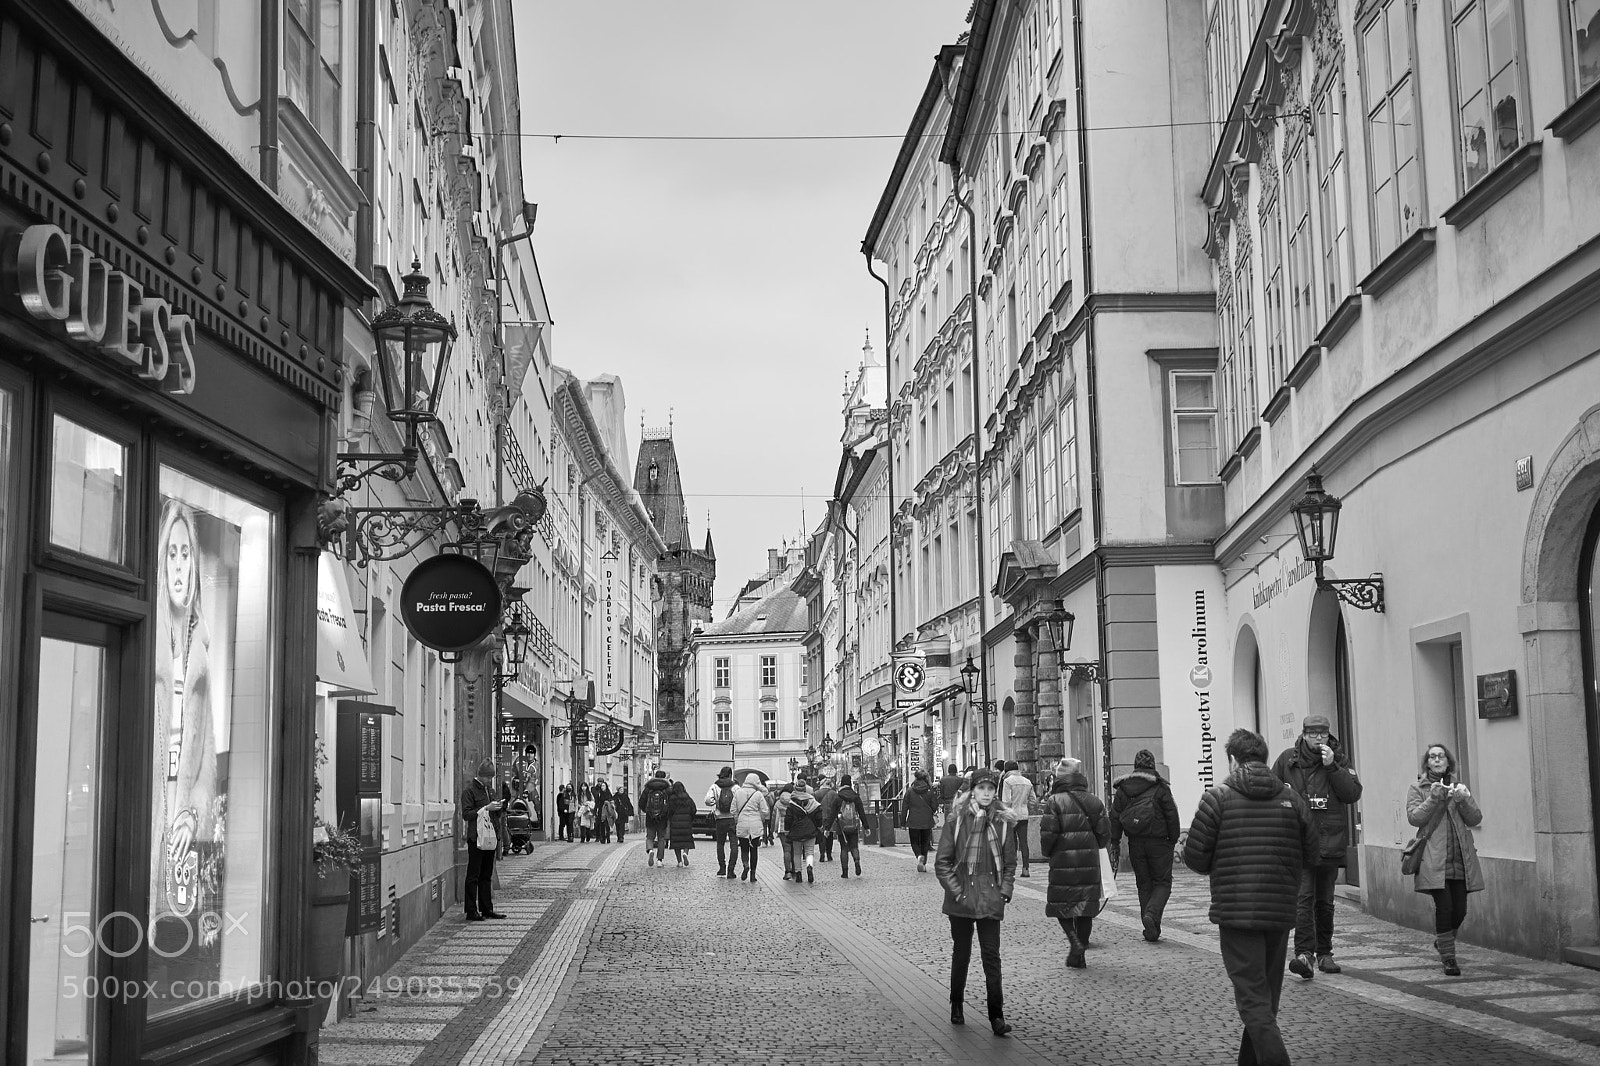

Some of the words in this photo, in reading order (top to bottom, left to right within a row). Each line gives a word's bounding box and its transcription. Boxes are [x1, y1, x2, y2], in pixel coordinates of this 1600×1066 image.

[18, 224, 196, 395] GUESS
[416, 602, 446, 612] Pasta
[448, 602, 486, 612] Fresca!
[428, 591, 447, 600] fresh
[448, 591, 473, 600] pasta?
[910, 736, 920, 772] BREWERY
[1194, 691, 1216, 793] nihkupectví
